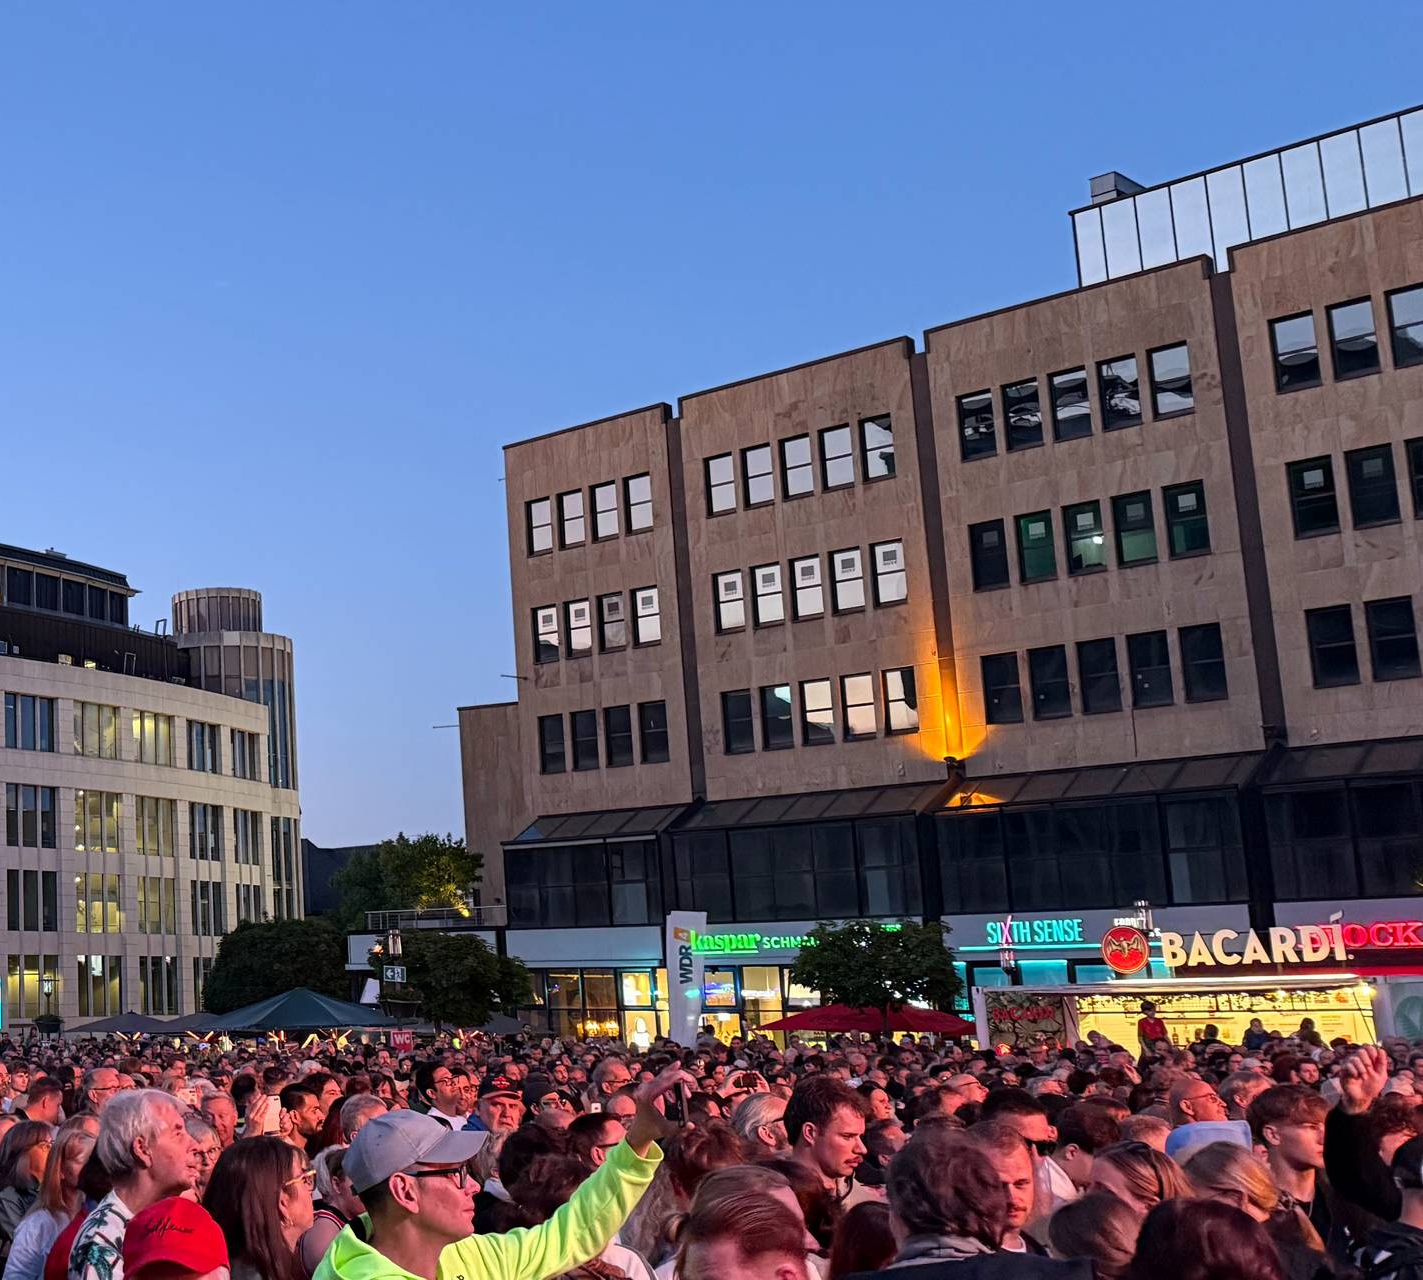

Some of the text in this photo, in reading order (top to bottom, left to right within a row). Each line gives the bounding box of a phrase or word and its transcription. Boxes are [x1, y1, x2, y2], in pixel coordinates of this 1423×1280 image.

[690, 929, 761, 951] kaspar
[986, 914, 1084, 944] SIXTH SENSE
[679, 945, 694, 984] WDR
[393, 1033, 411, 1045] WC
